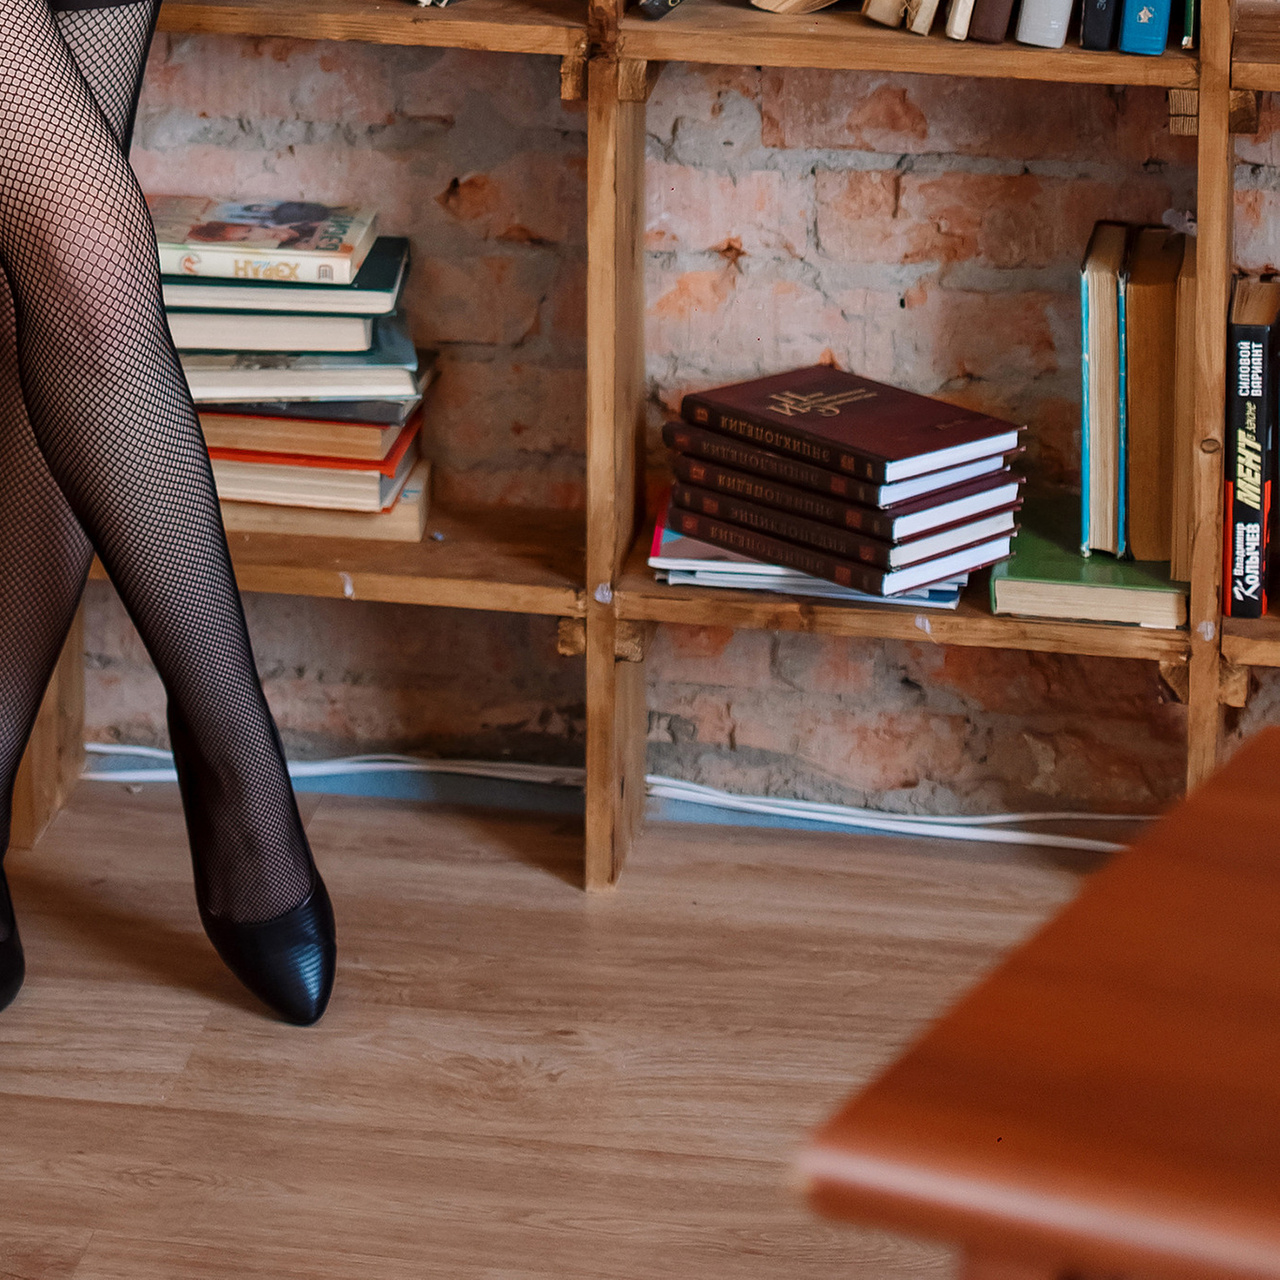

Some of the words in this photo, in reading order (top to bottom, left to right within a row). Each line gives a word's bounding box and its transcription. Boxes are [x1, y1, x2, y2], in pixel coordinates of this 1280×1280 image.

[1238, 341, 1252, 396] СИЛОВОЙ
[1251, 342, 1263, 396] ВАРИАНТ
[1232, 522, 1261, 601] КОЛЫЧЕВ
[1233, 522, 1246, 577] Владимир
